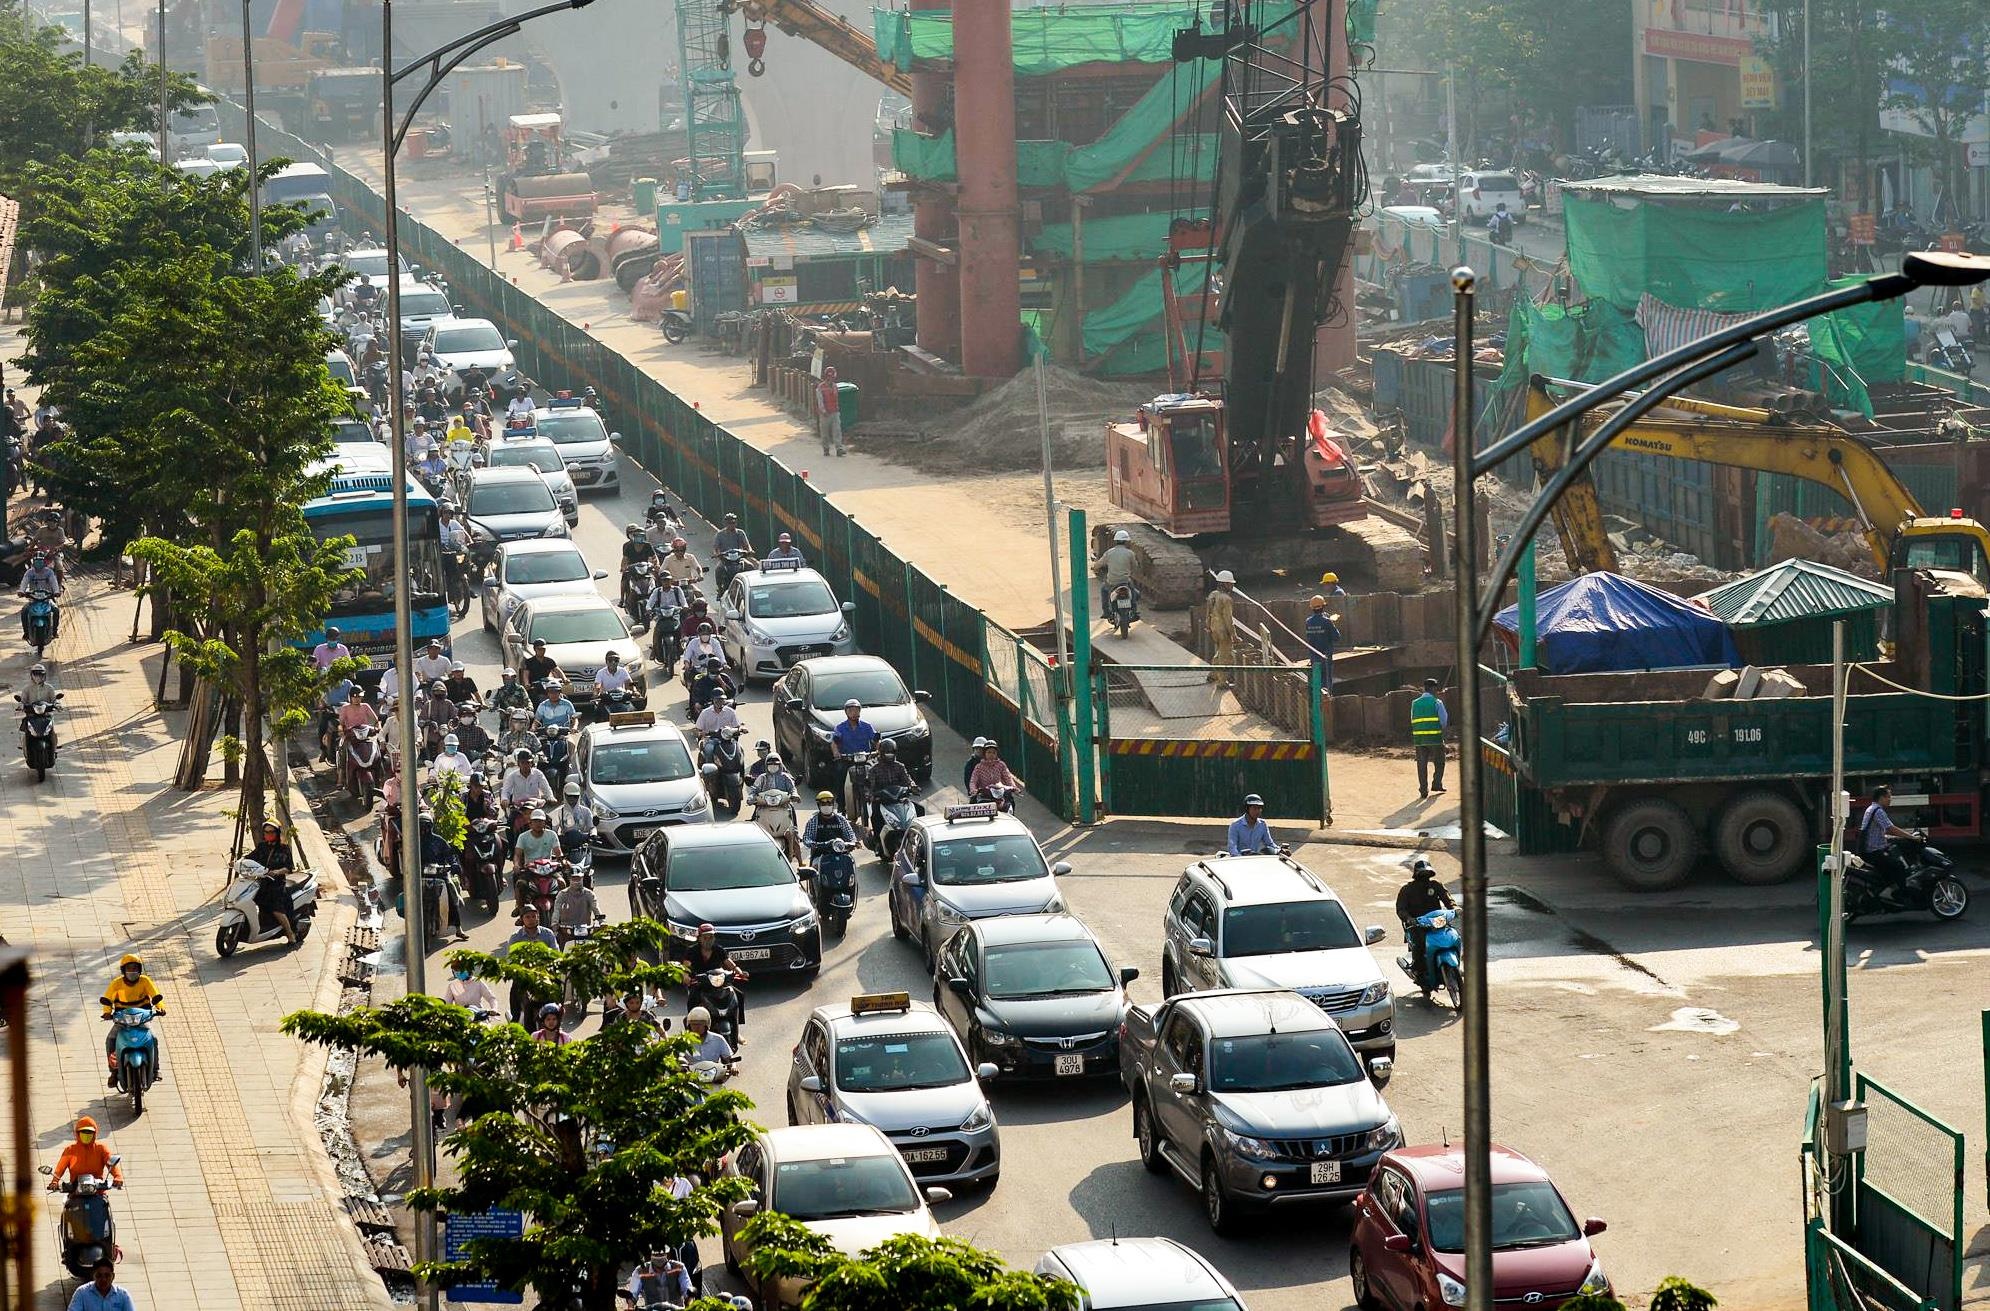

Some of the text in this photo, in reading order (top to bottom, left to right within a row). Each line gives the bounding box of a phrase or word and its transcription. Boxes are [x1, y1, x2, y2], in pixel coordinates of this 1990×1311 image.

[1624, 436, 1673, 451] KOMATSU
[1687, 730, 1706, 744] 49C
[1061, 1055, 1078, 1065] 30U
[1059, 1064, 1081, 1074] 4978
[1318, 1162, 1334, 1173] 29H
